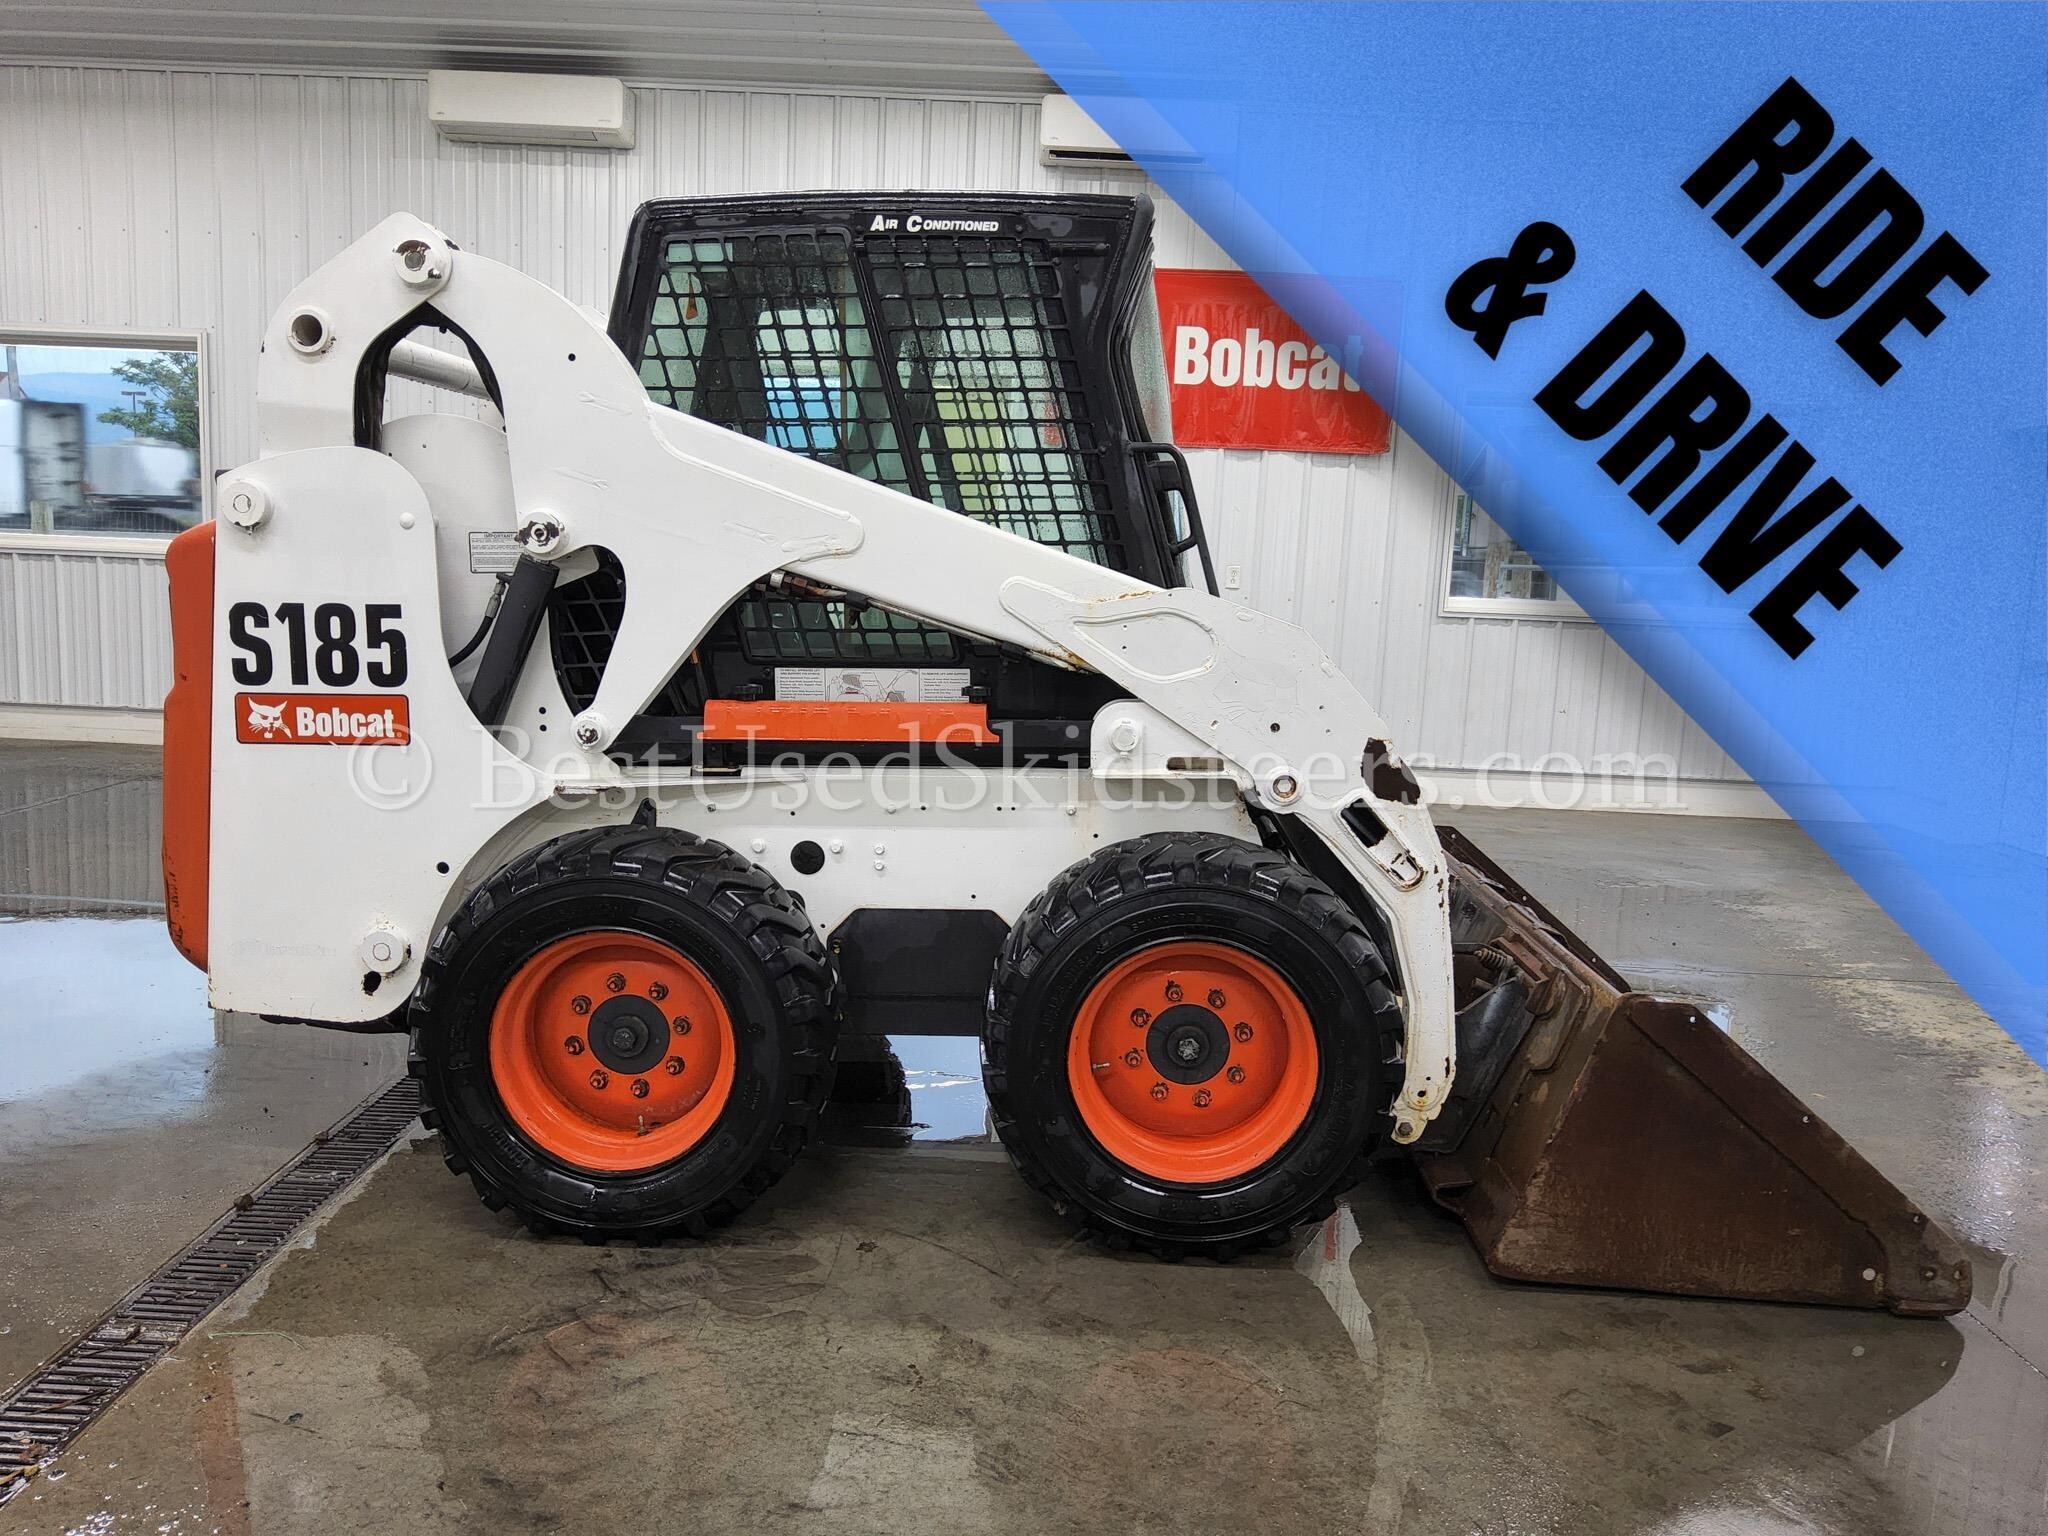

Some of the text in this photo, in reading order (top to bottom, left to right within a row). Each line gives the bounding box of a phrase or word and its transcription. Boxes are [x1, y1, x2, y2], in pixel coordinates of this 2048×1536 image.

[869, 215, 999, 232] AIR CONDITIONED
[1174, 325, 1364, 393] Bobcat
[228, 601, 408, 688] S185
[295, 706, 396, 738] Bobcat
